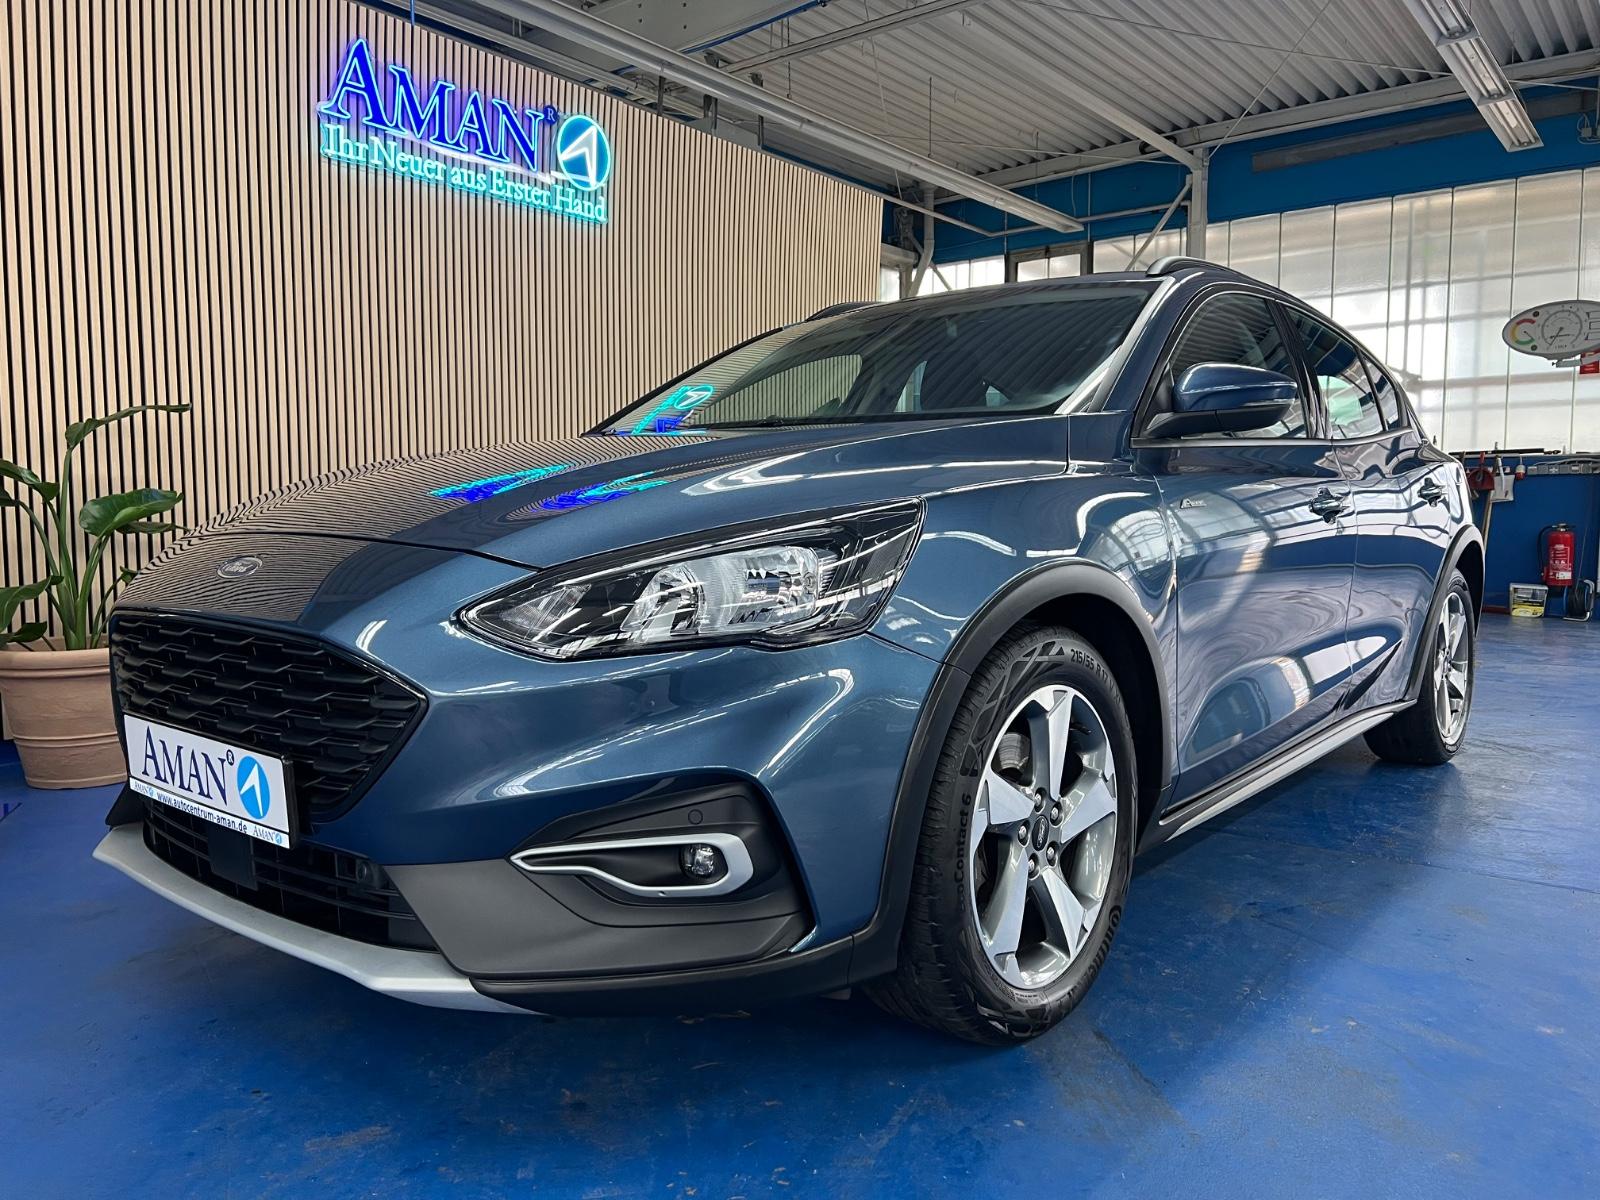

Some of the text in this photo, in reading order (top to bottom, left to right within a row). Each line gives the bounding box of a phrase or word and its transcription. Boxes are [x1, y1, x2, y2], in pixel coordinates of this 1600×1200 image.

[322, 123, 608, 223] Ihr Neuer aus Erster Hand
[1070, 648, 1095, 671] 215/55
[156, 791, 248, 835] www.autocentrum-aman.de
[961, 792, 972, 806] 6
